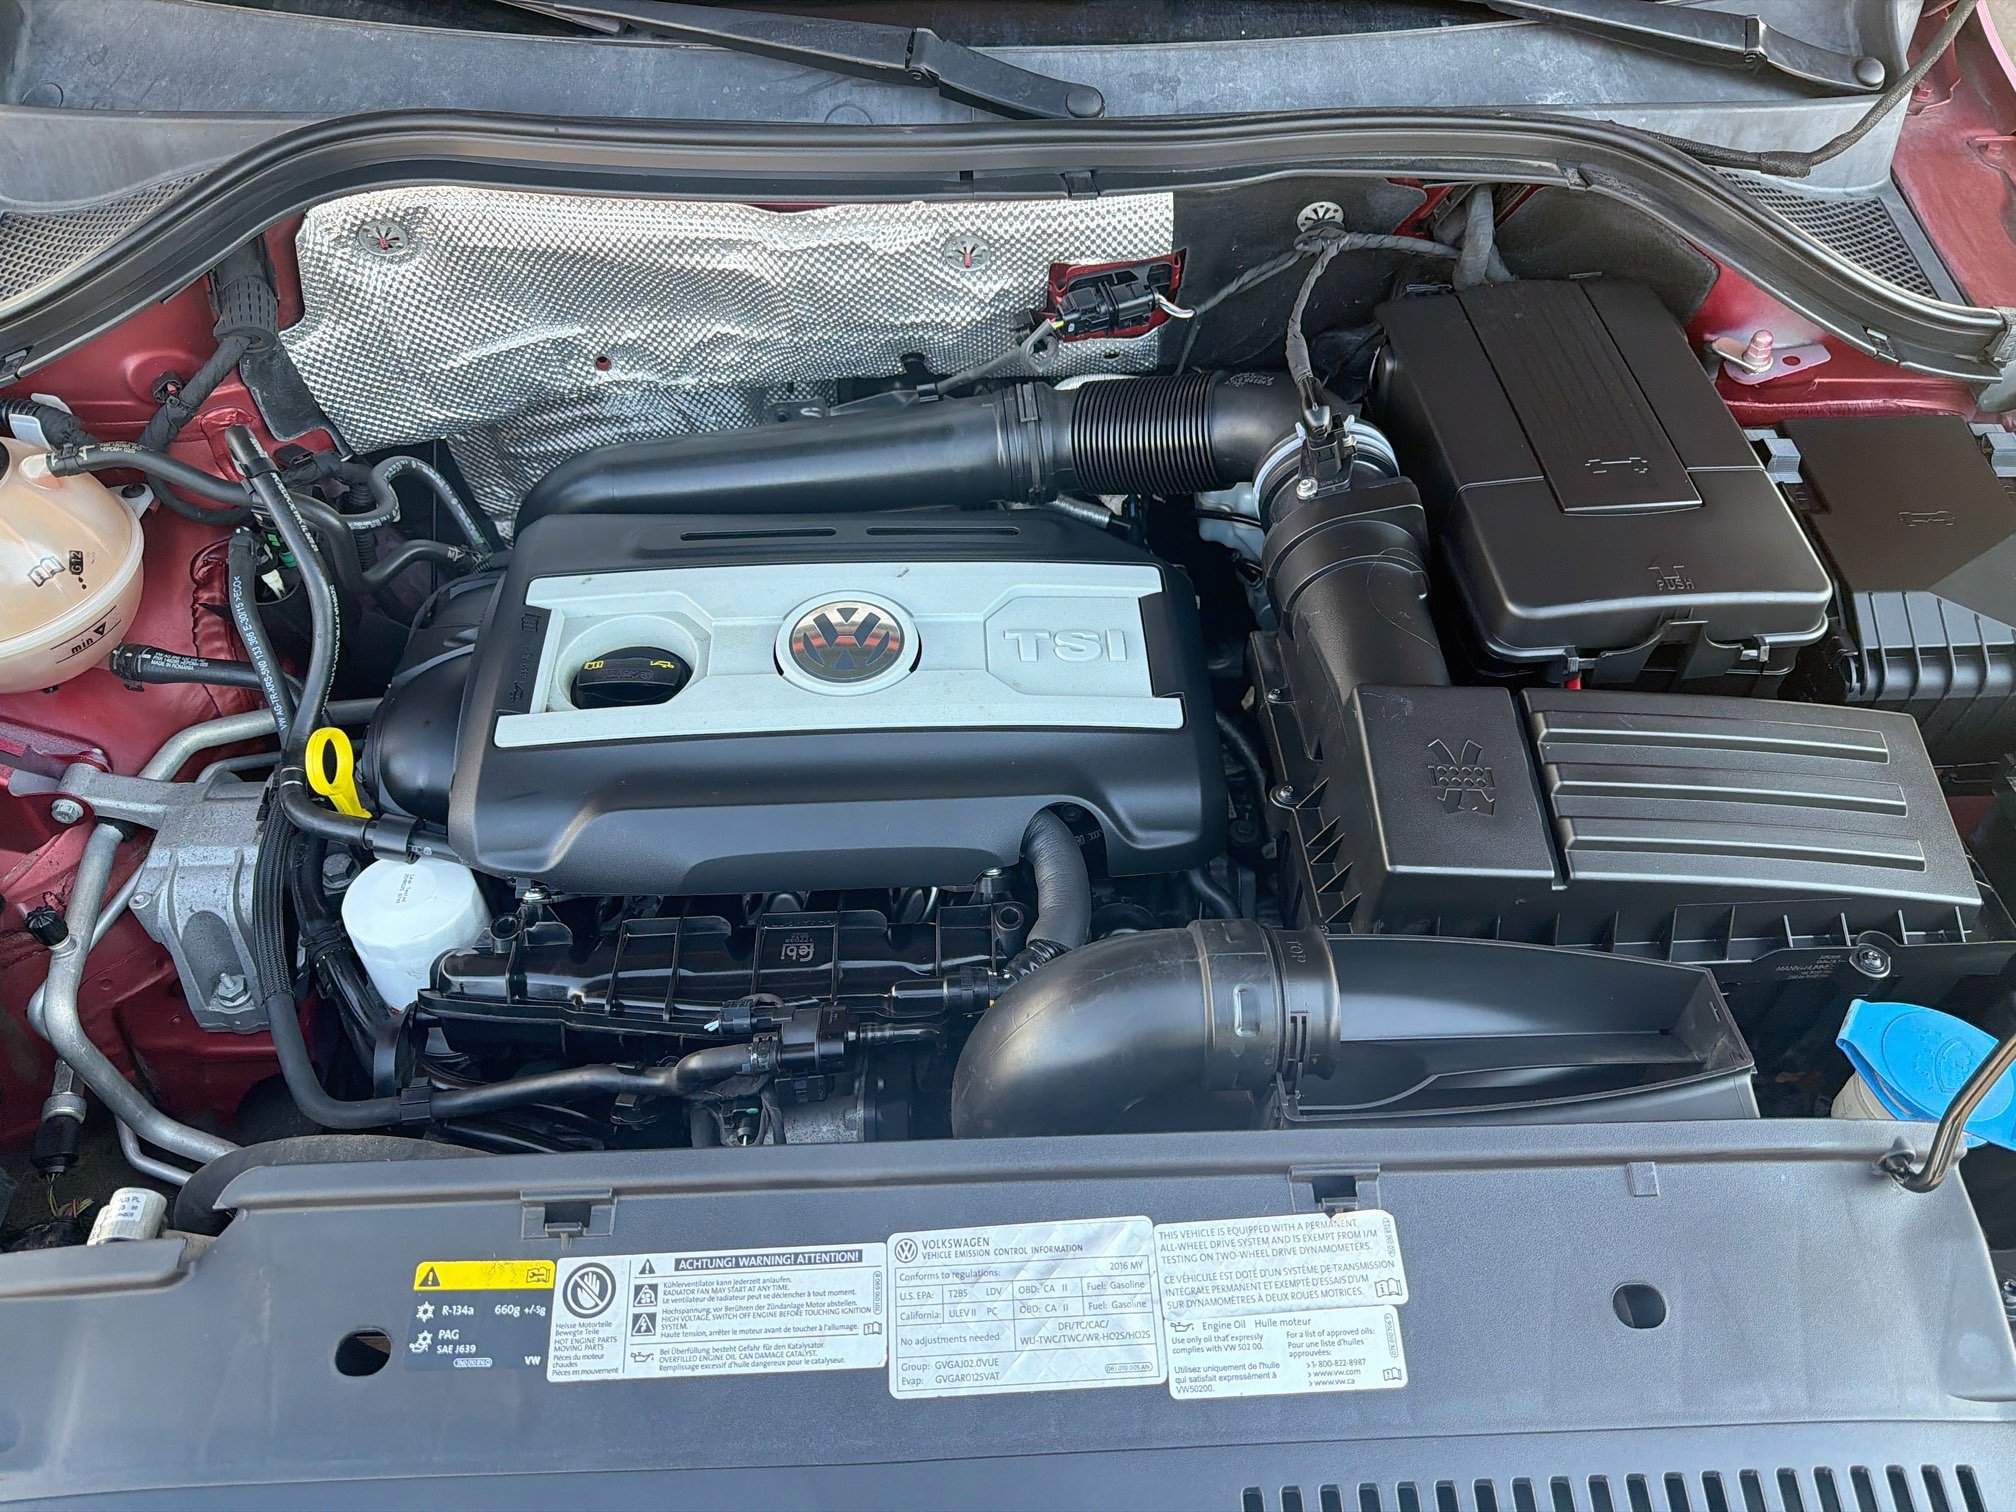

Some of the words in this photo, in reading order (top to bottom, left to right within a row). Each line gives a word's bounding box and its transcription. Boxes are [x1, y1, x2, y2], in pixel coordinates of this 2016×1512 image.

[70, 551, 82, 572] G12
[1656, 578, 1694, 590] PUSH
[71, 638, 94, 654] min
[252, 644, 263, 659] 133
[1003, 628, 1127, 663] TSI
[278, 716, 287, 730] VW
[780, 943, 815, 962] febi
[1286, 941, 1306, 962] TOP
[1159, 1231, 1178, 1240] THIS
[1179, 1228, 1215, 1239] VEHICLE
[1217, 1227, 1225, 1236] IS
[1227, 1225, 1270, 1236] EQUIPPED
[1271, 1223, 1295, 1232] WITH
[1298, 1222, 1303, 1230] A
[1306, 1219, 1357, 1230] PERMANENT
[922, 1237, 990, 1249] VOLKSWAGEN
[1160, 1242, 1208, 1252] ALL-WHEEL
[1210, 1239, 1235, 1249] DRIVE
[1238, 1237, 1269, 1246] SYSTEM
[1271, 1235, 1291, 1244] AND
[1303, 1232, 1334, 1242] EXEMPT
[1338, 1231, 1360, 1239] FROM
[1363, 1230, 1377, 1238] I/M
[922, 1250, 952, 1260] VEHICLE
[954, 1249, 990, 1258] EMISSION
[994, 1247, 1028, 1256] CONTROL
[1031, 1244, 1083, 1254] INFORMATION
[1162, 1254, 1197, 1264] TESTING
[1200, 1253, 1214, 1262] ON
[1216, 1250, 1268, 1261] TWO-WHEEL
[1272, 1246, 1297, 1256] DRIVE
[1300, 1242, 1372, 1255] DYNAMOMETERS.
[679, 1257, 735, 1270] ACHTUNG!
[738, 1255, 794, 1267] WARNING!
[797, 1251, 858, 1265] ATTENTION!
[1110, 1262, 1128, 1270] 2016
[1130, 1261, 1143, 1269] MY
[899, 1273, 939, 1282] Conforms
[952, 1269, 1000, 1280] regulations:
[1164, 1276, 1174, 1284] CE
[1176, 1273, 1217, 1283] VÉHICULE
[1220, 1272, 1233, 1280] EST
[1236, 1269, 1257, 1279] DOTÉ
[1260, 1268, 1282, 1277] D'UN
[1283, 1265, 1318, 1275] SYSTÈME
[663, 1287, 695, 1296] RADIATOR
[697, 1286, 709, 1294] FAN
[900, 1292, 915, 1300] U.S.
[917, 1291, 934, 1300] EPA:
[986, 1287, 1002, 1296] LDV
[1018, 1285, 1040, 1294] OBD:
[1087, 1282, 1106, 1291] Fuel:
[1110, 1280, 1144, 1290] Gasoline
[1166, 1285, 1209, 1296] INTÉGRALE
[1212, 1282, 1261, 1293] PERMANENT
[1312, 1277, 1346, 1286] D'ESSAIS
[1167, 1301, 1184, 1309] SUR
[1186, 1295, 1255, 1308] DYNAMOMÈTRES
[1258, 1293, 1263, 1302] À
[1266, 1292, 1289, 1302] DEUX
[1291, 1291, 1319, 1300] ROUES
[1321, 1288, 1363, 1298] MOTRICES.
[442, 1305, 474, 1316] R-134a
[494, 1305, 520, 1317] 660g
[524, 1305, 546, 1317] +/-5g
[900, 1311, 941, 1321] California:
[948, 1309, 970, 1318] ULEV
[987, 1307, 997, 1316] PC
[1020, 1304, 1041, 1313] OBD:
[1088, 1301, 1108, 1310] Fuel:
[1058, 1320, 1109, 1331] DFI/TC/CAC/
[1202, 1322, 1232, 1332] Engine
[1234, 1320, 1246, 1329] Oil
[1279, 1318, 1311, 1326] moteur
[438, 1330, 460, 1340] PAG
[1186, 1336, 1202, 1345] only
[1231, 1333, 1263, 1344] expressly
[1327, 1328, 1359, 1337] approved
[900, 1337, 912, 1346] No
[915, 1334, 967, 1347] adjustments
[969, 1333, 1000, 1342] needed
[436, 1345, 453, 1354] SAE
[455, 1344, 476, 1354] J639
[1173, 1346, 1204, 1355] complies
[524, 1356, 541, 1366] VW
[901, 1362, 930, 1373] Group:
[1313, 1369, 1361, 1377] www.vw.com
[901, 1376, 924, 1387] Evap:
